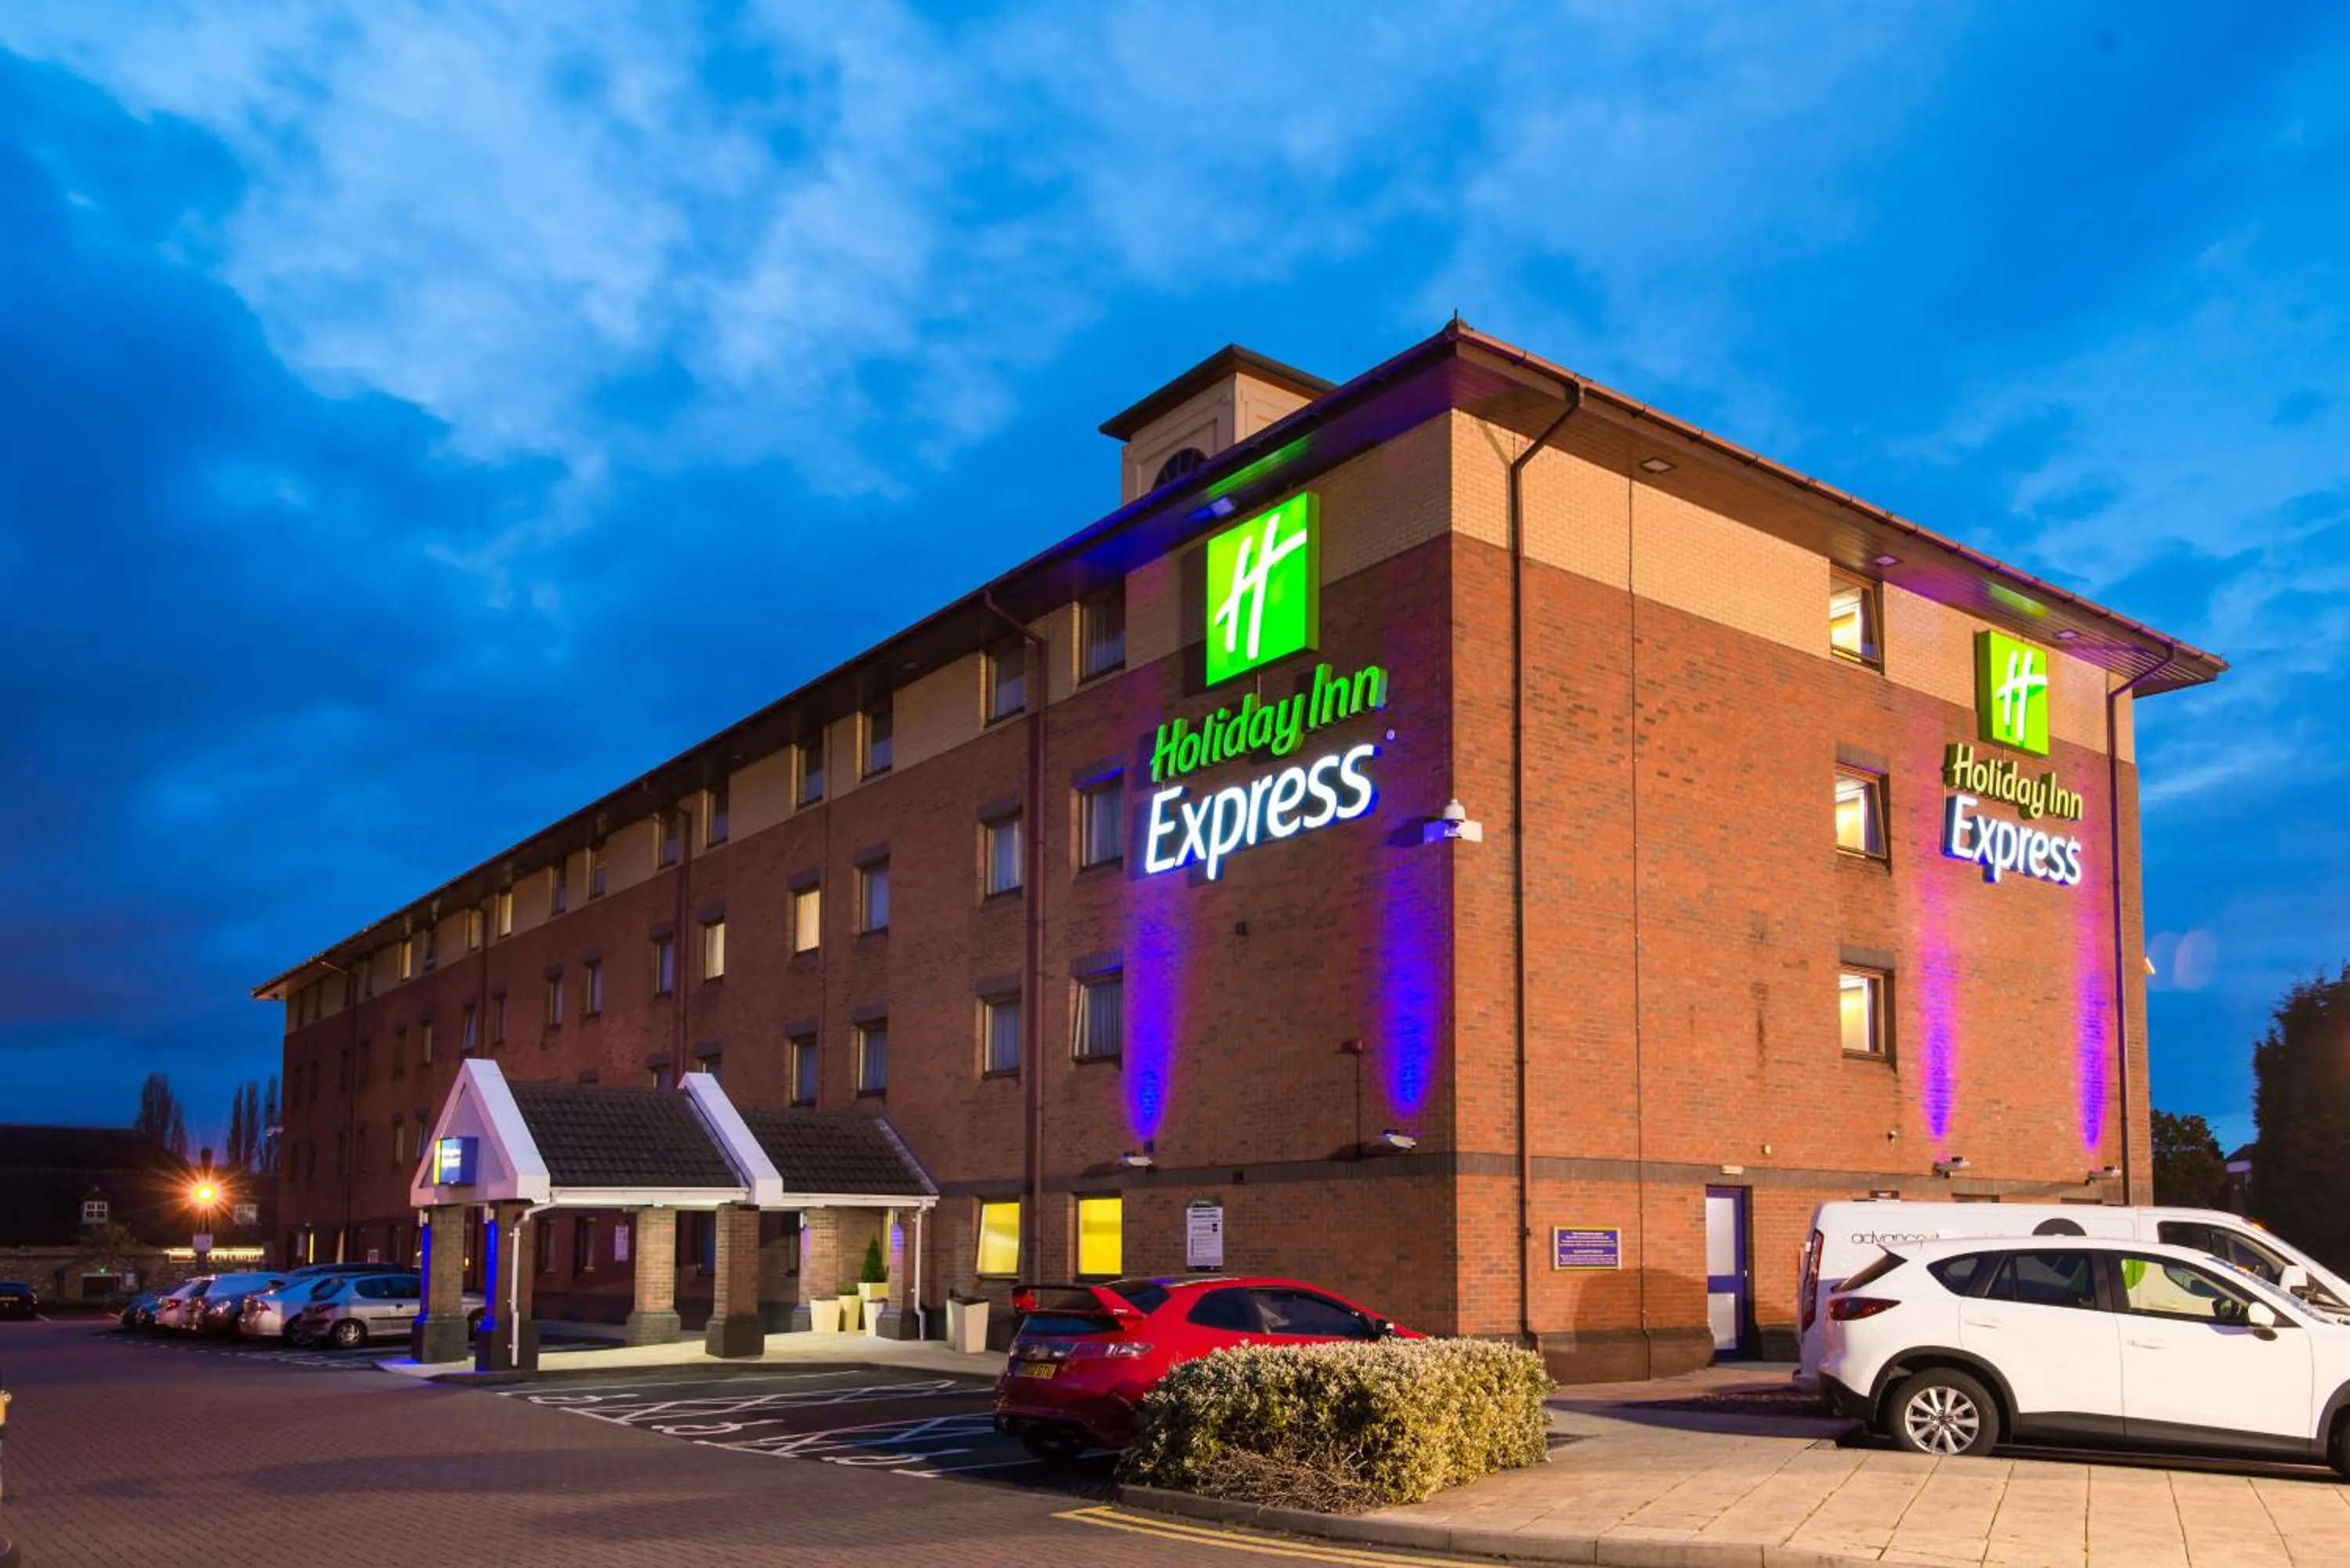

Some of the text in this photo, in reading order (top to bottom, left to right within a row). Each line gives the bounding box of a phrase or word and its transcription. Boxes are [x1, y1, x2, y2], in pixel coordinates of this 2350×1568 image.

[1151, 663, 1388, 783] Holiday Inn
[1144, 742, 1377, 881] Express
[1950, 742, 2084, 821] Holiday Inn
[1950, 794, 2082, 886] Express
